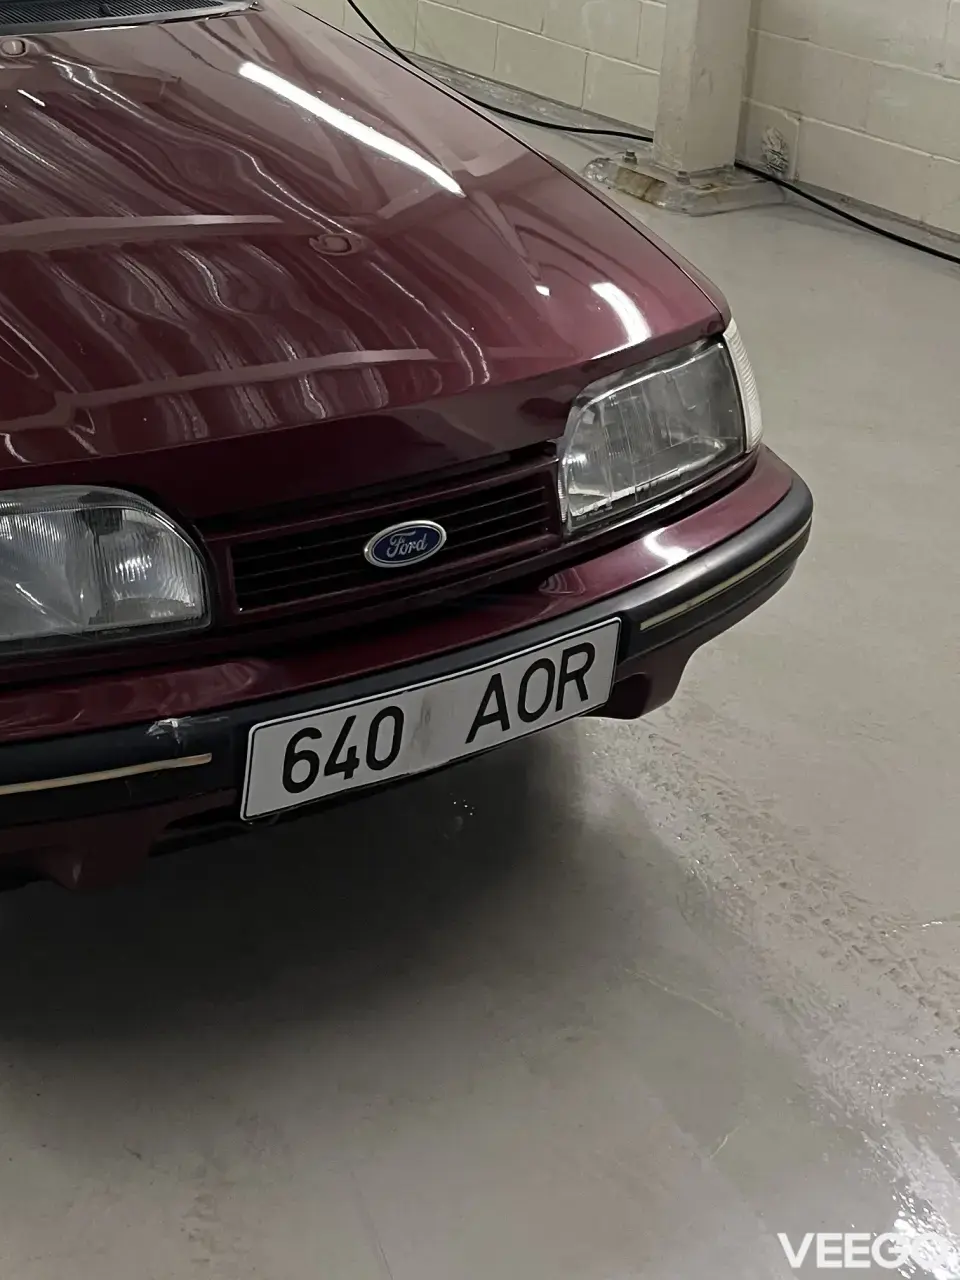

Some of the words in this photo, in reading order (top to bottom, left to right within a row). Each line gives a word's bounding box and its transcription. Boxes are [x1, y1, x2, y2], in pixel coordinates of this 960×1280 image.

[386, 530, 428, 558] Ford
[282, 705, 404, 794] 640
[465, 642, 595, 744] AOR
